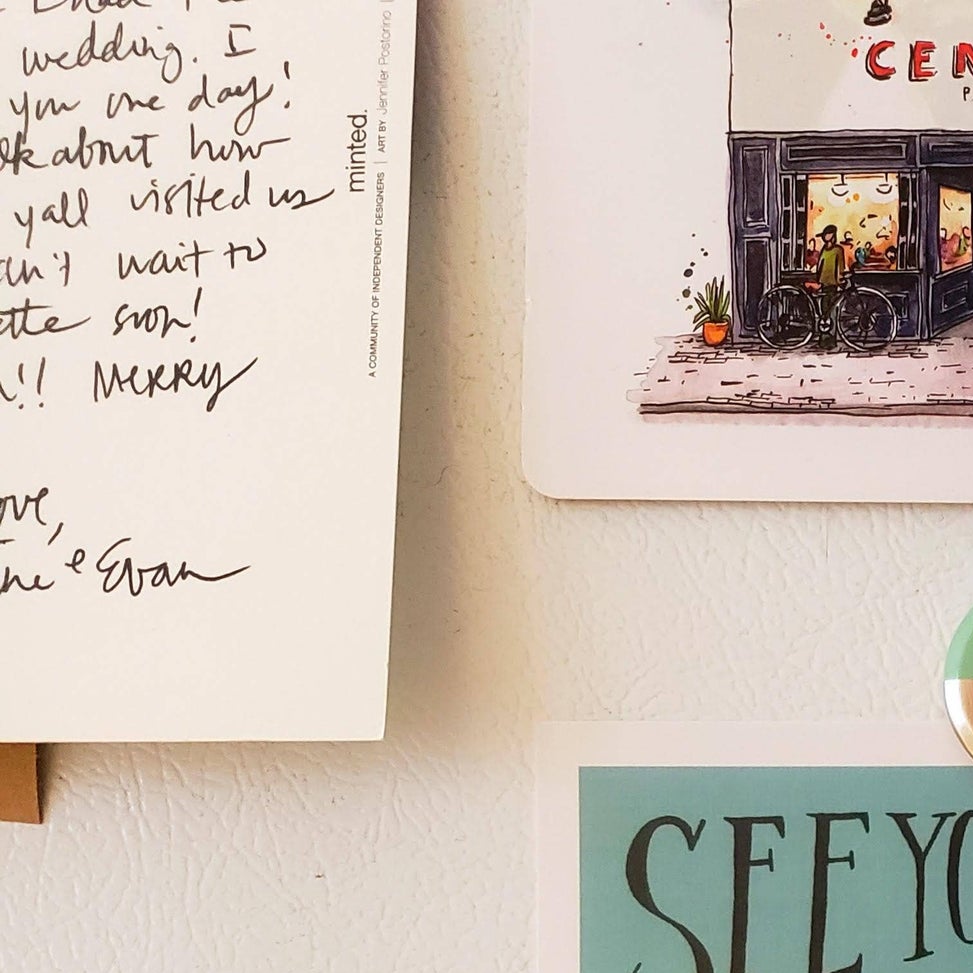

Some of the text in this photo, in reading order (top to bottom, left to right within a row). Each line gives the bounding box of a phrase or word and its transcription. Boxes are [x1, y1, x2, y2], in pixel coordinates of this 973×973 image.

[23, 20, 256, 84] wedding. I
[9, 61, 291, 143] you one day!
[376, 70, 390, 116] Jennifer
[51, 126, 160, 169] about
[190, 123, 291, 162] how
[345, 109, 368, 193] minted.
[377, 134, 387, 153] ART
[378, 120, 387, 132] BY
[130, 170, 251, 218] visited
[268, 186, 336, 210] us
[374, 171, 386, 226] DESIGNERS
[118, 240, 214, 280] wait
[223, 237, 267, 269] to
[372, 228, 384, 293] INDEPENDENT
[112, 287, 203, 343] soon!
[371, 295, 380, 309] OF
[368, 310, 380, 370] COMMUNITY
[368, 369, 377, 378] A
[96, 537, 252, 597] Evan
